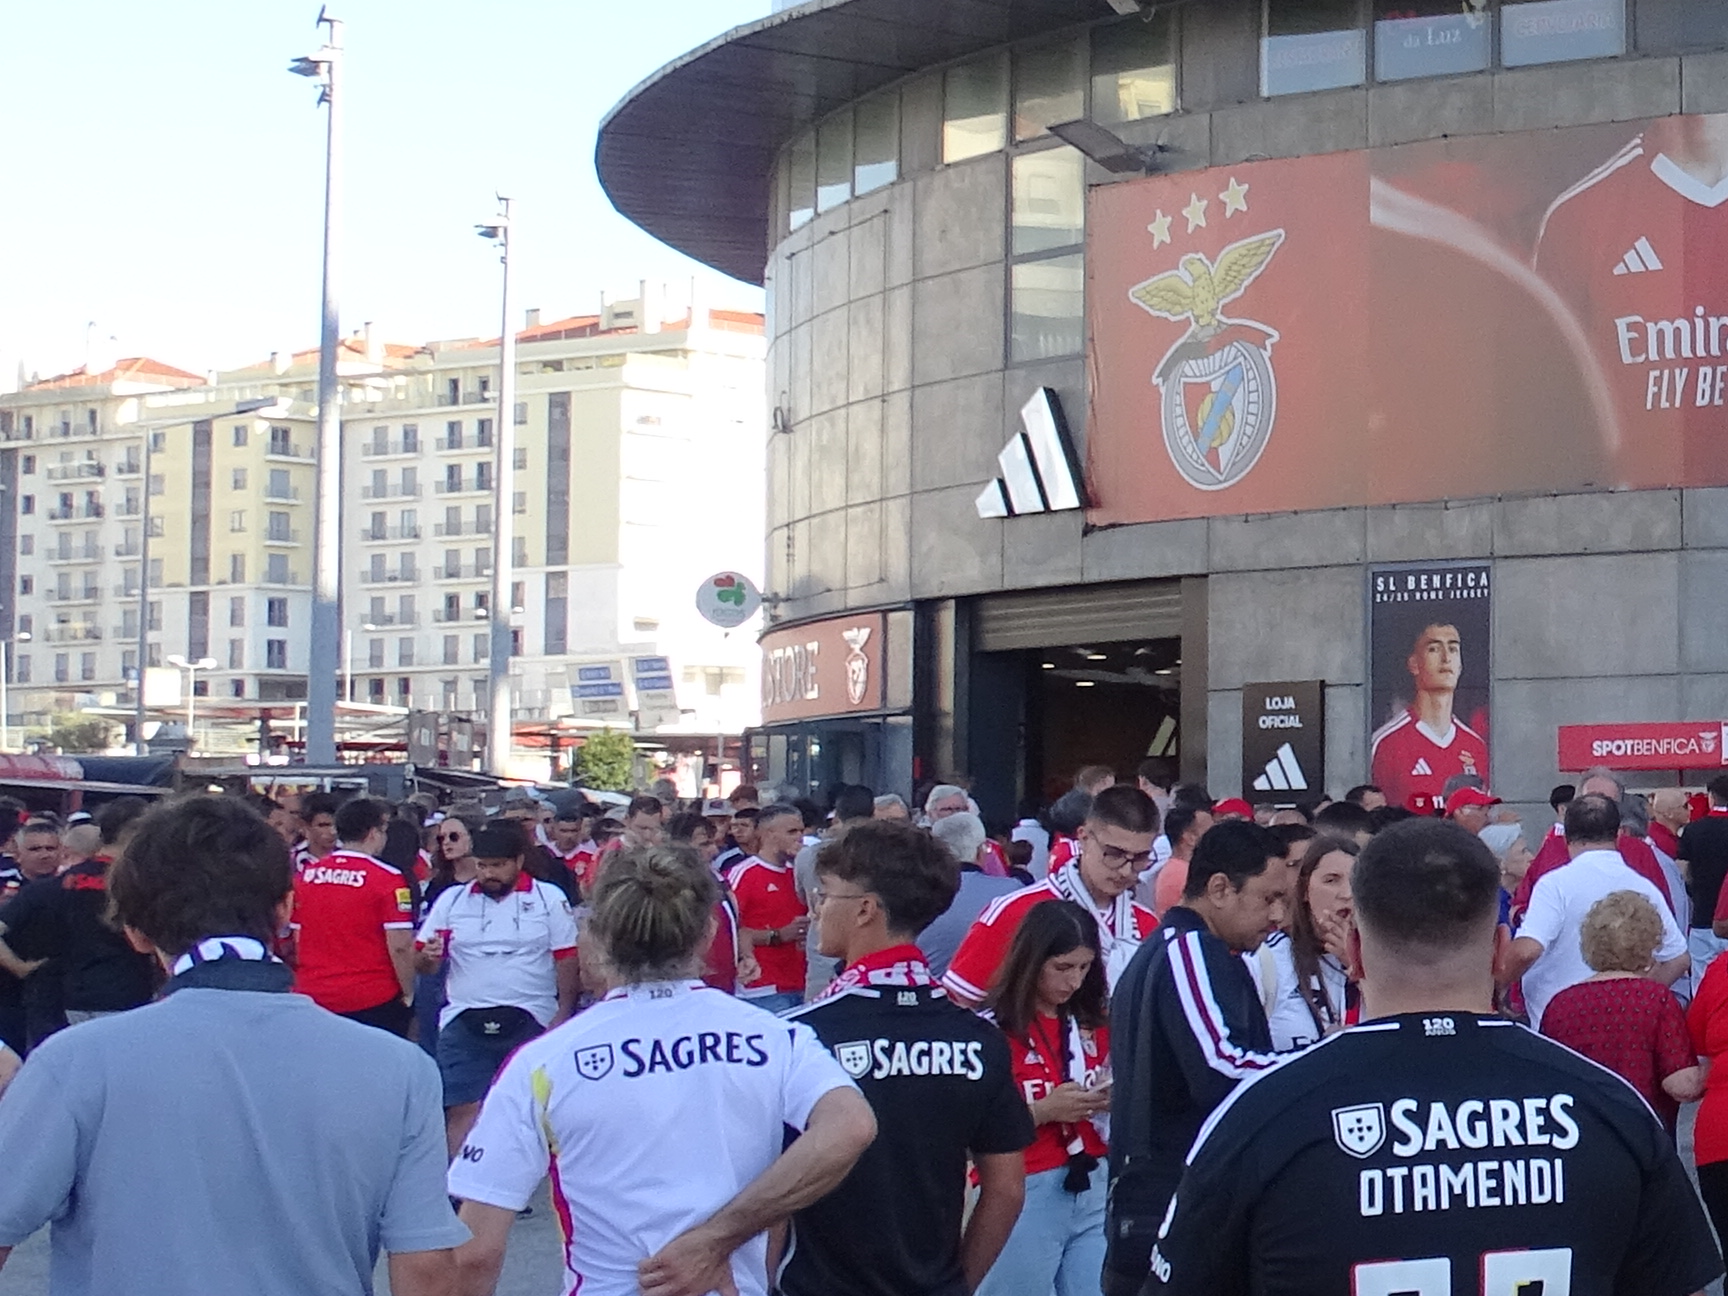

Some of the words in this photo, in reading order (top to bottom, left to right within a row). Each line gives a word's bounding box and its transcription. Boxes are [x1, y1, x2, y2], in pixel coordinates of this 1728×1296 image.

[1646, 365, 1688, 410] FLY
[1377, 574, 1398, 591] SL
[1407, 571, 1489, 591] BENFICA
[1265, 696, 1296, 710] LOJA
[1258, 715, 1303, 730] OFICIAL
[1592, 737, 1699, 757] SPOTBENFICA
[314, 866, 366, 888] SAGRES
[649, 987, 673, 1000] 120
[1422, 1017, 1455, 1031] 120
[623, 1032, 769, 1079] SAGRES
[872, 1040, 984, 1082] SAGRES
[1391, 1093, 1580, 1158] SAGRES
[1359, 1157, 1565, 1217] OTAMENDI
